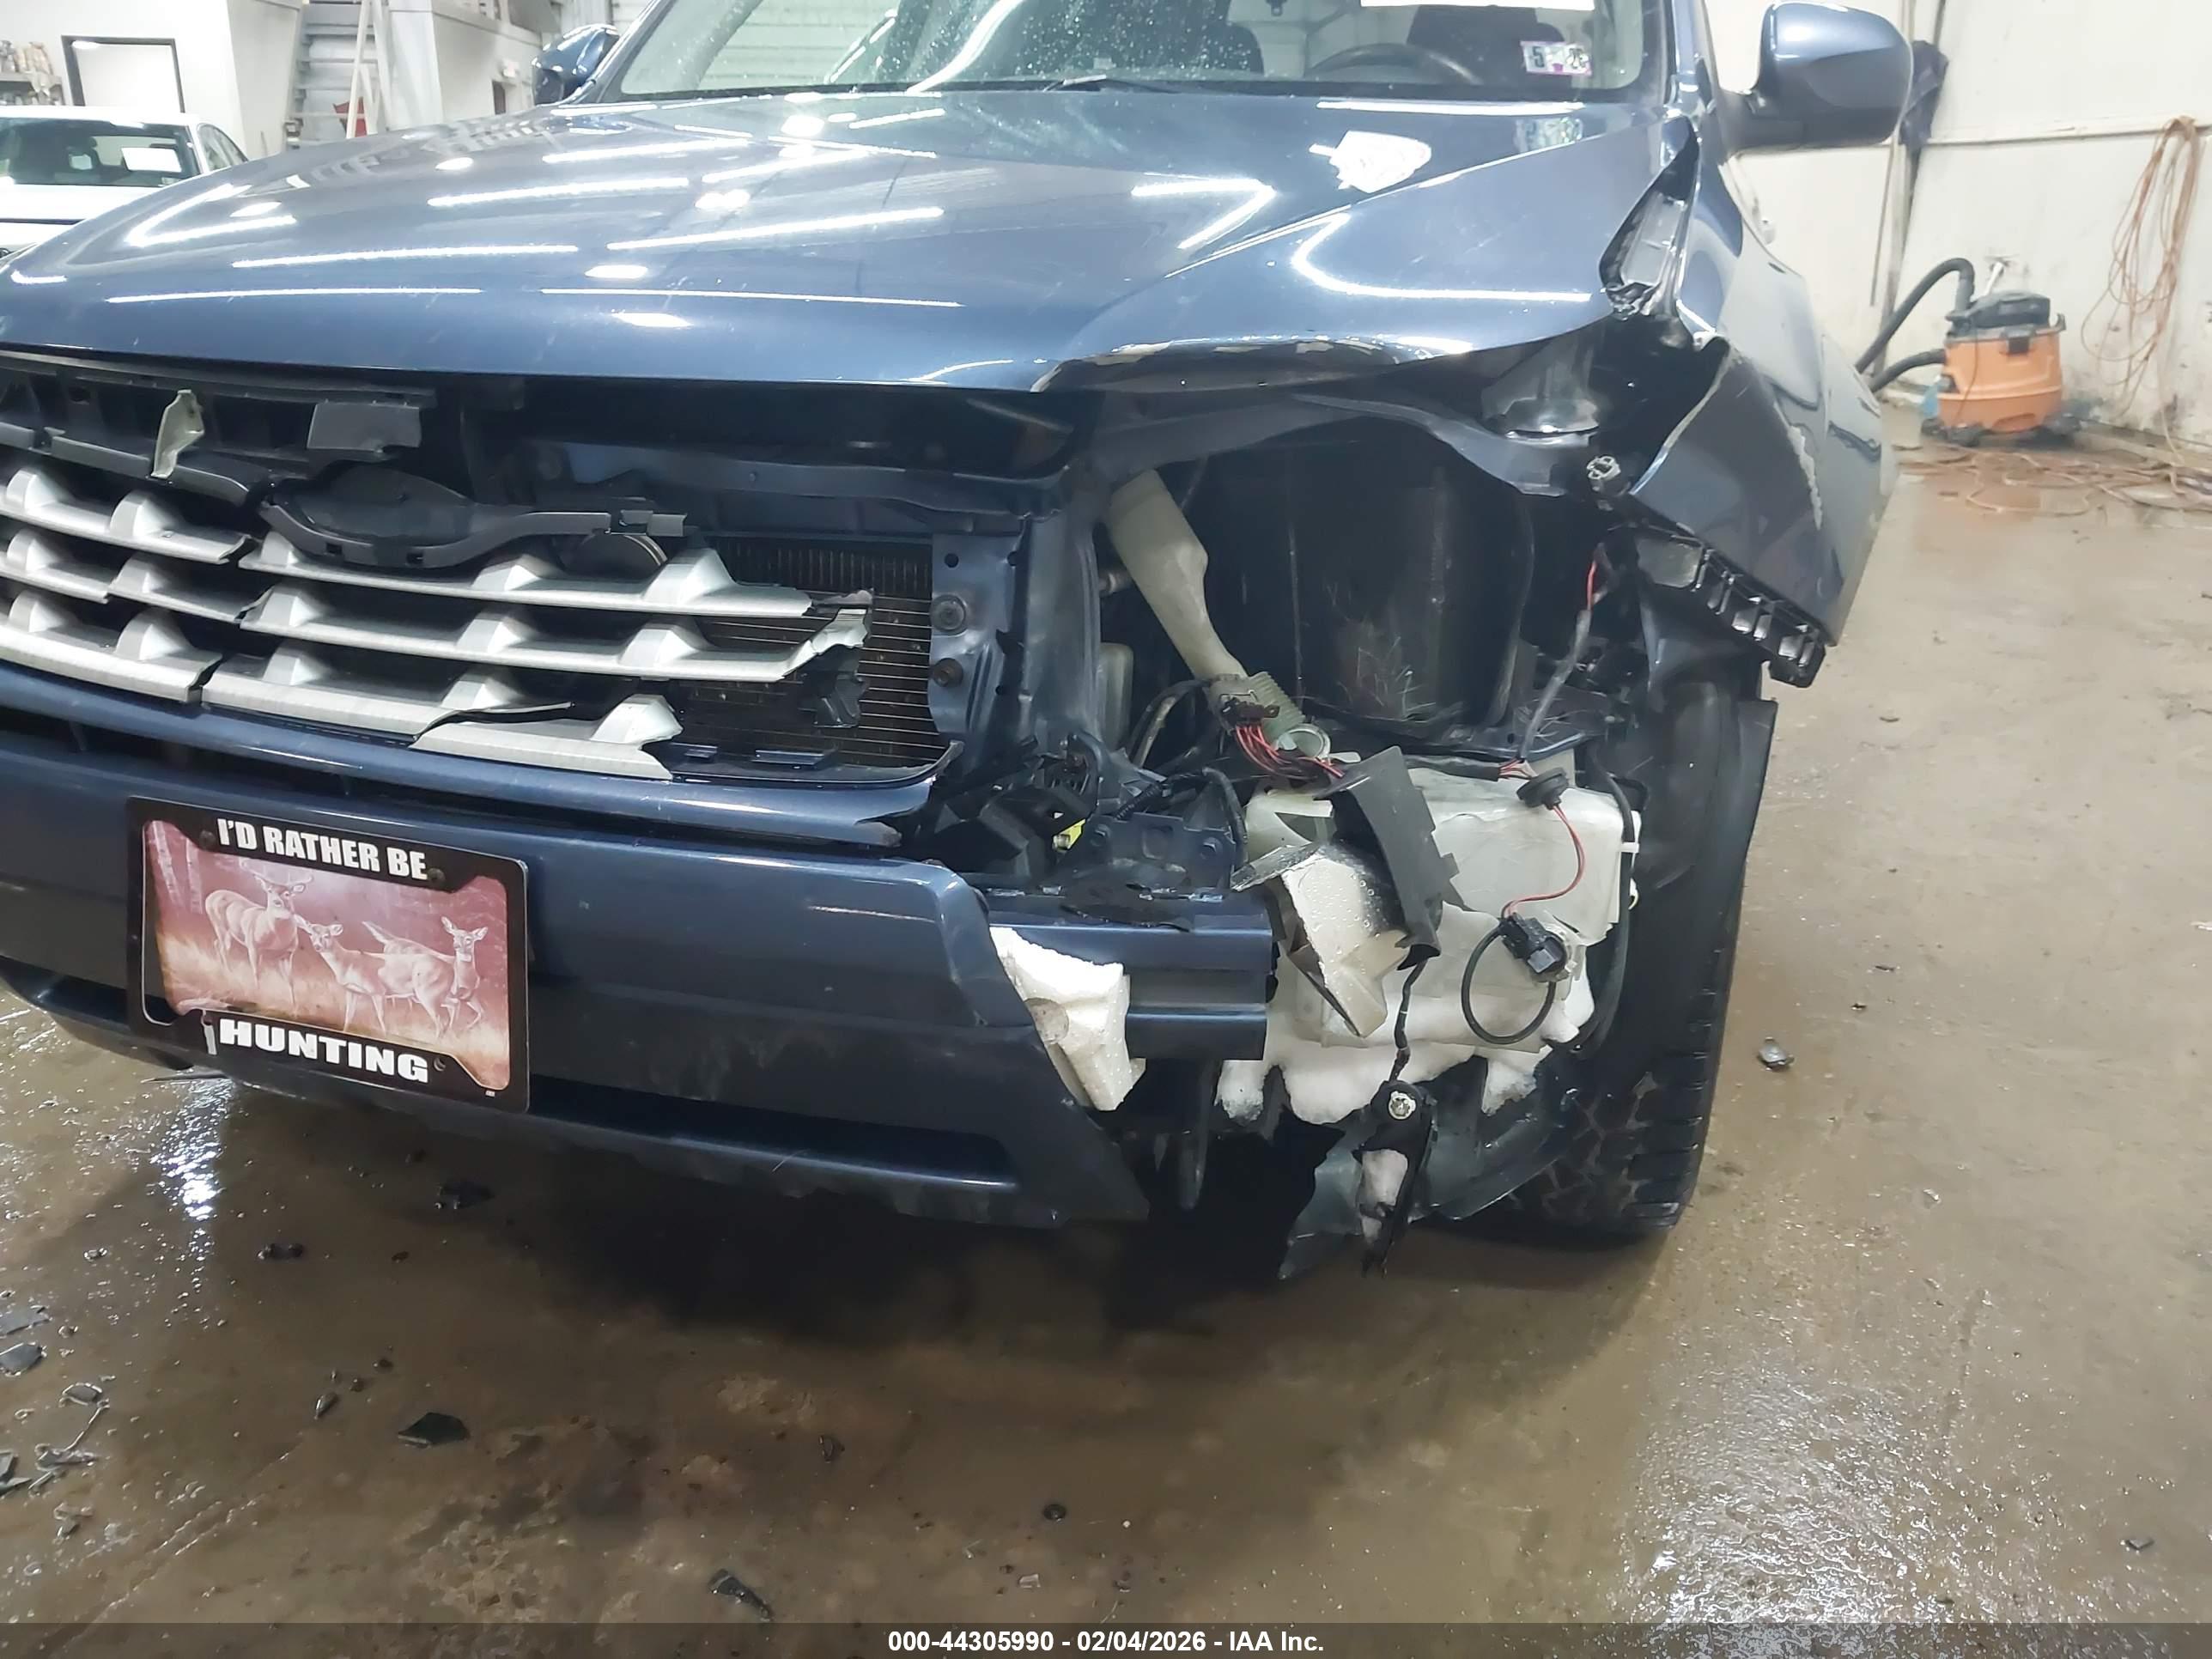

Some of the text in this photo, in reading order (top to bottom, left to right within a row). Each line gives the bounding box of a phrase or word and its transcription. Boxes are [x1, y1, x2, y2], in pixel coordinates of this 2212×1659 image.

[217, 818, 428, 880] I'D RATHER BE
[219, 1018, 428, 1084] HUNTING
